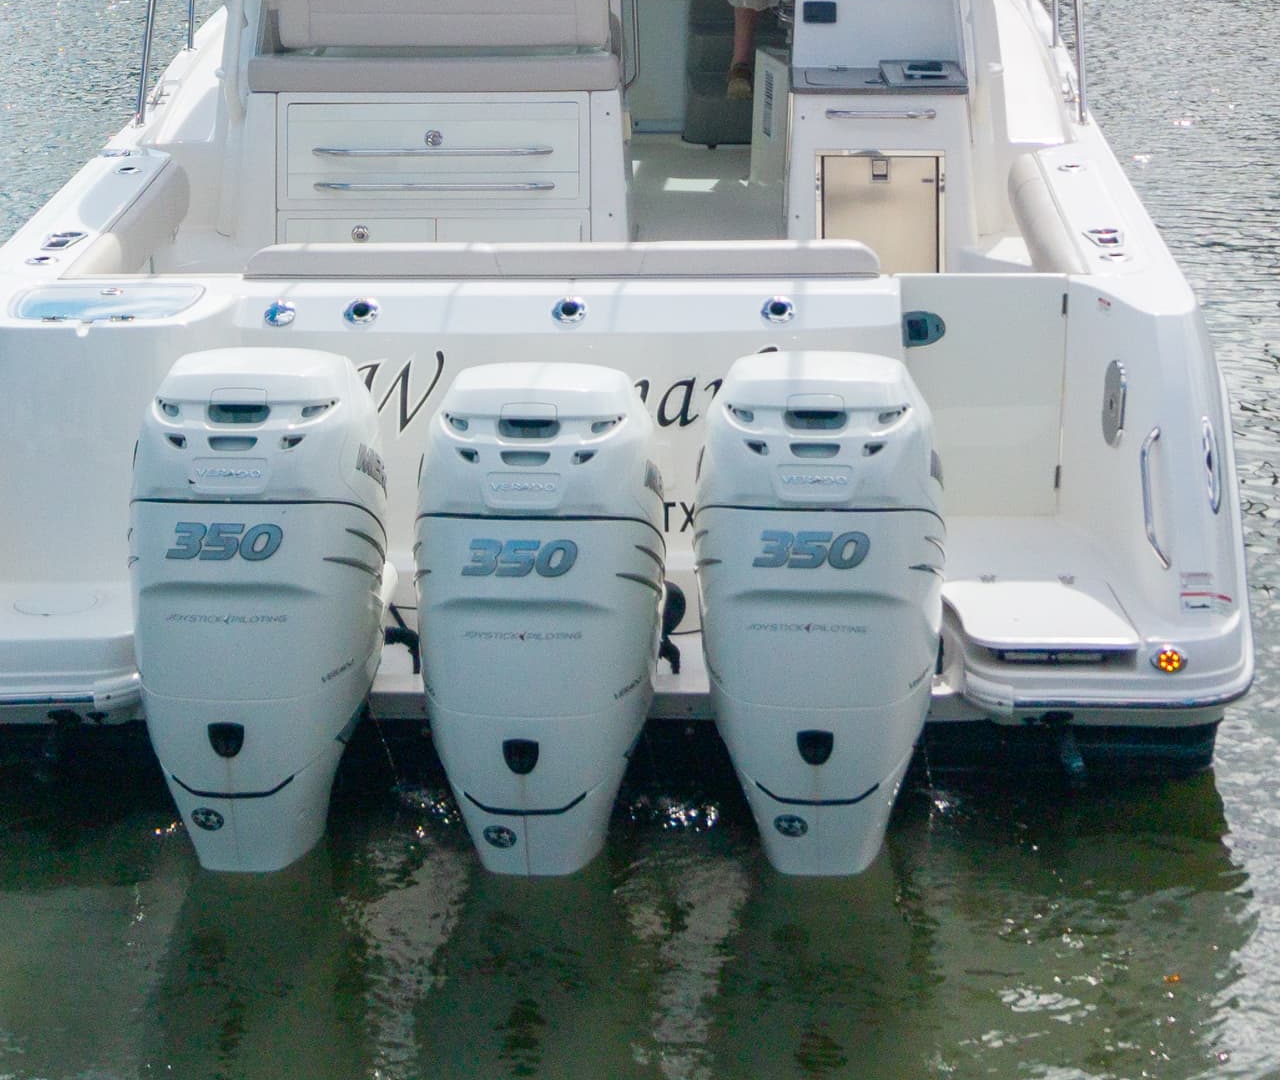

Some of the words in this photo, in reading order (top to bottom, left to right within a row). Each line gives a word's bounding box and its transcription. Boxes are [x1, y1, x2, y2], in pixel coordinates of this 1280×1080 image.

[663, 501, 695, 533] TX
[165, 521, 283, 562] 350
[461, 538, 577, 577] 350
[752, 529, 870, 569] 350
